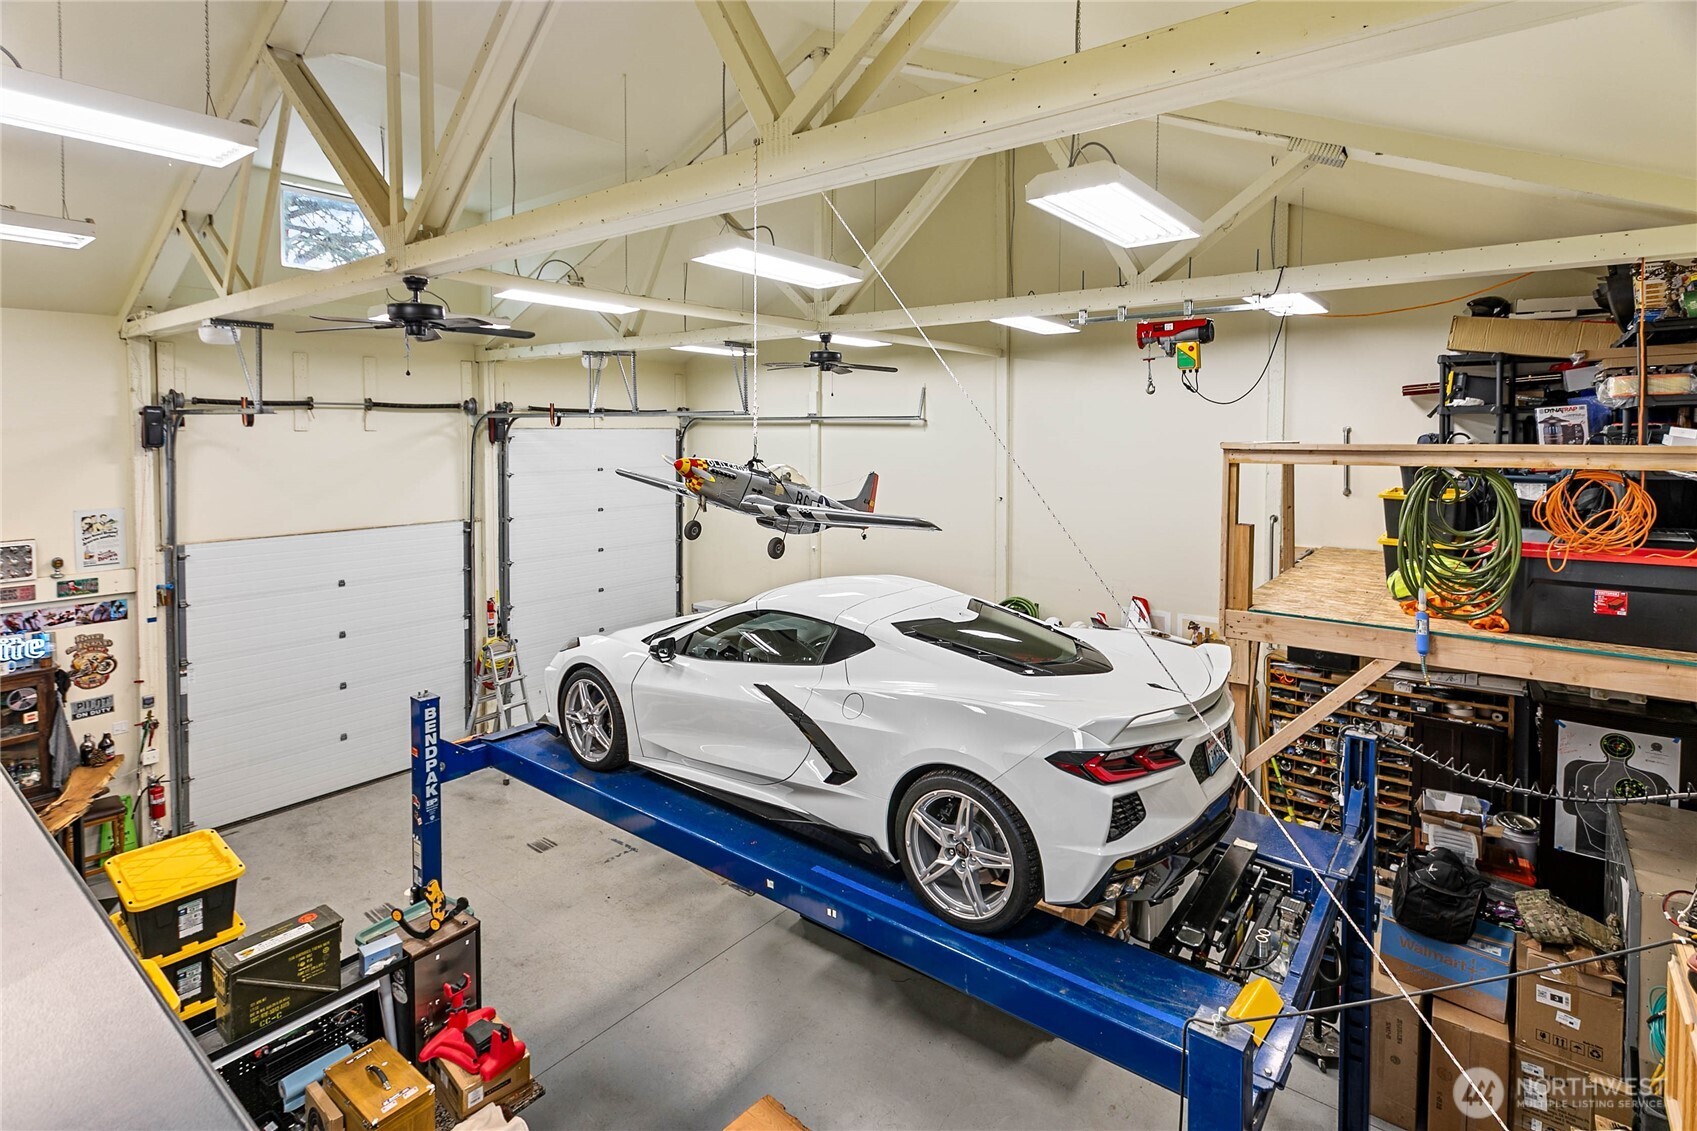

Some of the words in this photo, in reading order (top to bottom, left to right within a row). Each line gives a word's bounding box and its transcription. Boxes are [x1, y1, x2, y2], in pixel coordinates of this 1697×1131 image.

[1544, 406, 1578, 414] DYNATRAP
[0, 637, 46, 662] ite
[75, 711, 88, 719] ON
[89, 706, 112, 716] DUTY
[76, 697, 110, 710] PILOT
[424, 707, 439, 799] BENDPAK
[1399, 935, 1468, 972] Walmart
